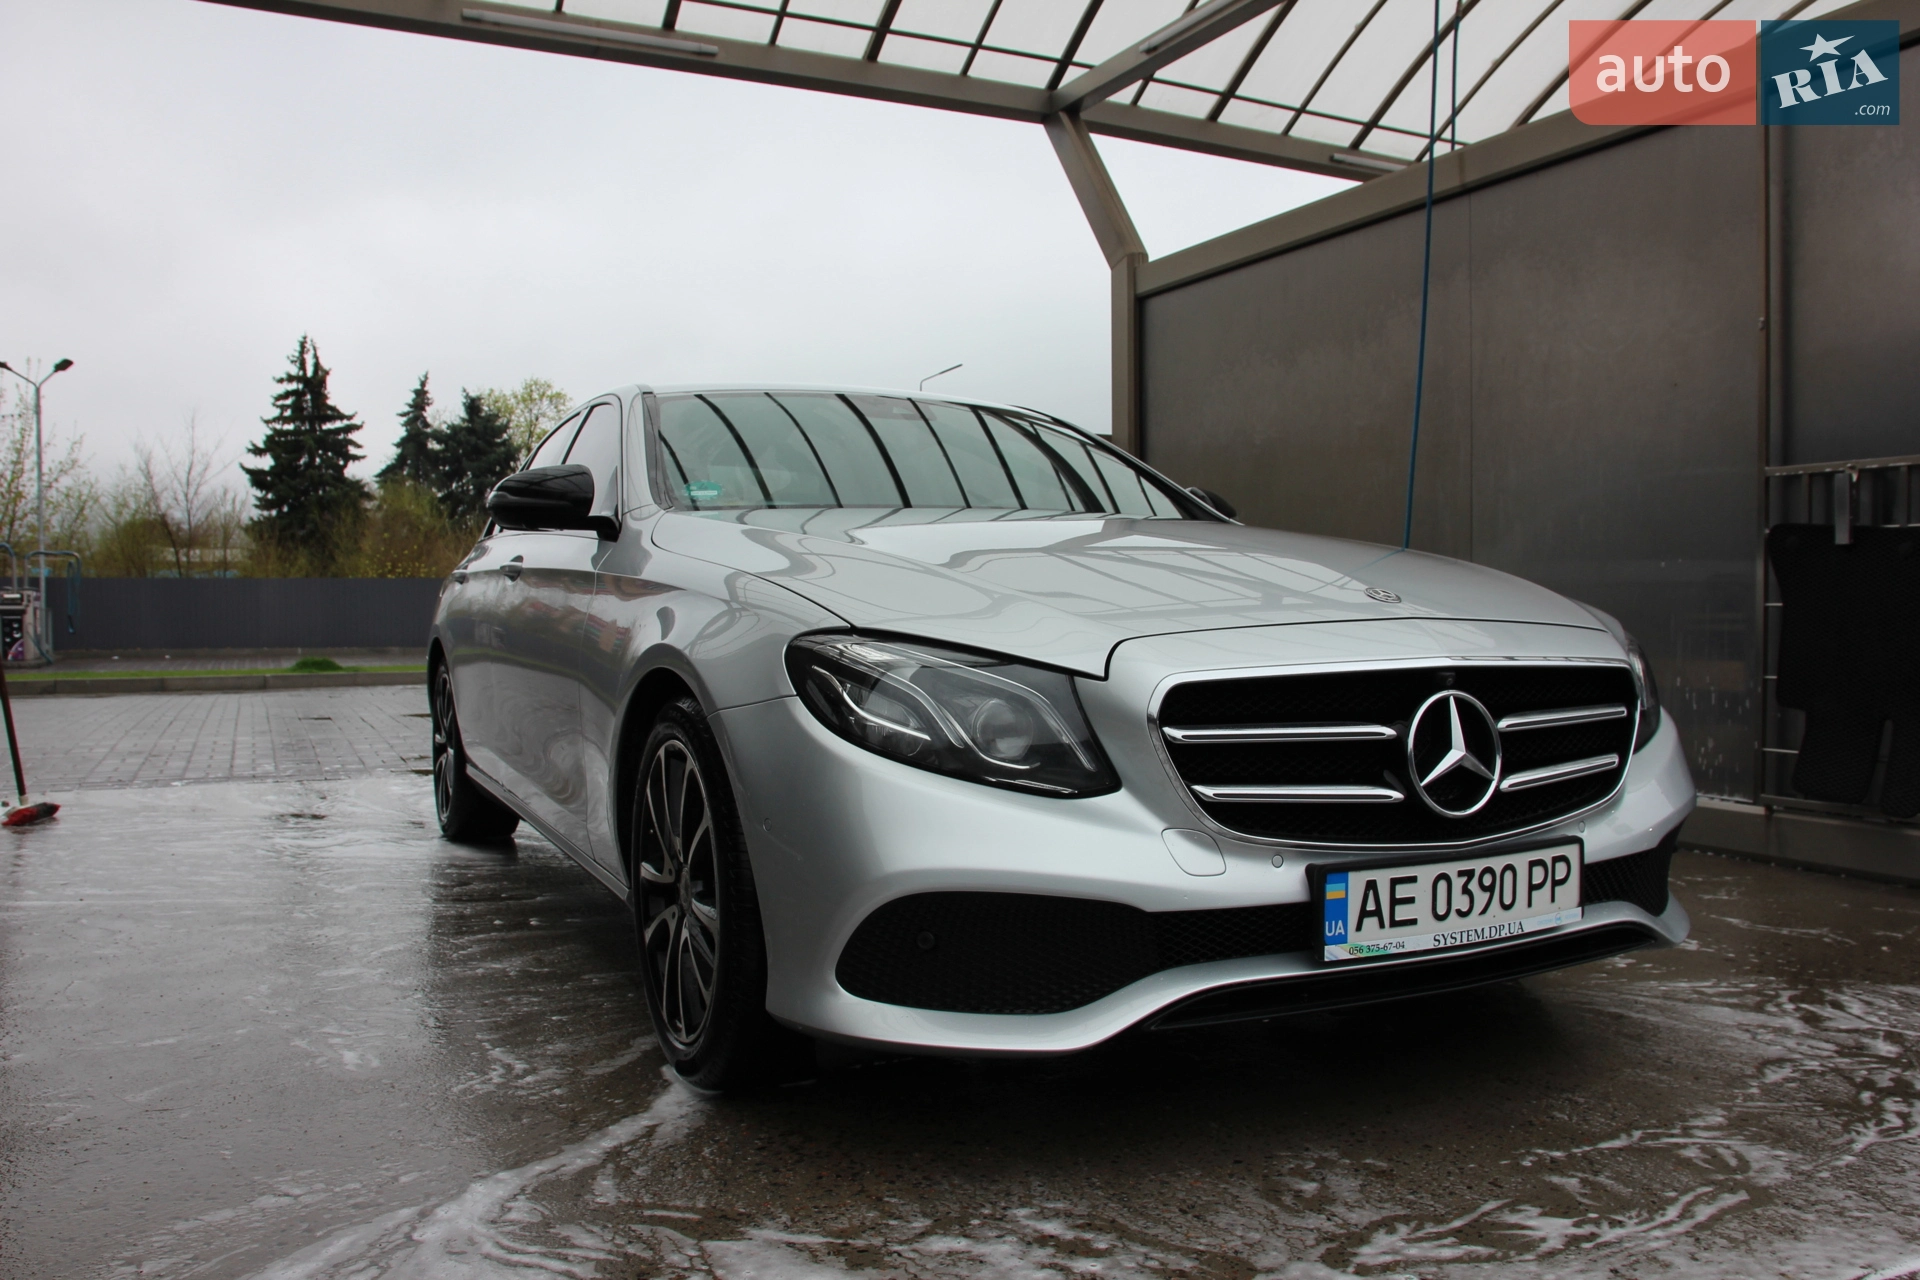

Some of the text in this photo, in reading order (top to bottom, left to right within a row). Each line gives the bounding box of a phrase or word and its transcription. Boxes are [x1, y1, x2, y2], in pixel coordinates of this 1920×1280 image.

[1355, 854, 1572, 932] AE 0390 PP
[1325, 919, 1345, 937] UA
[1432, 921, 1525, 948] SYSTEM.DP.UA
[1348, 941, 1406, 956] 056 375-67-04
